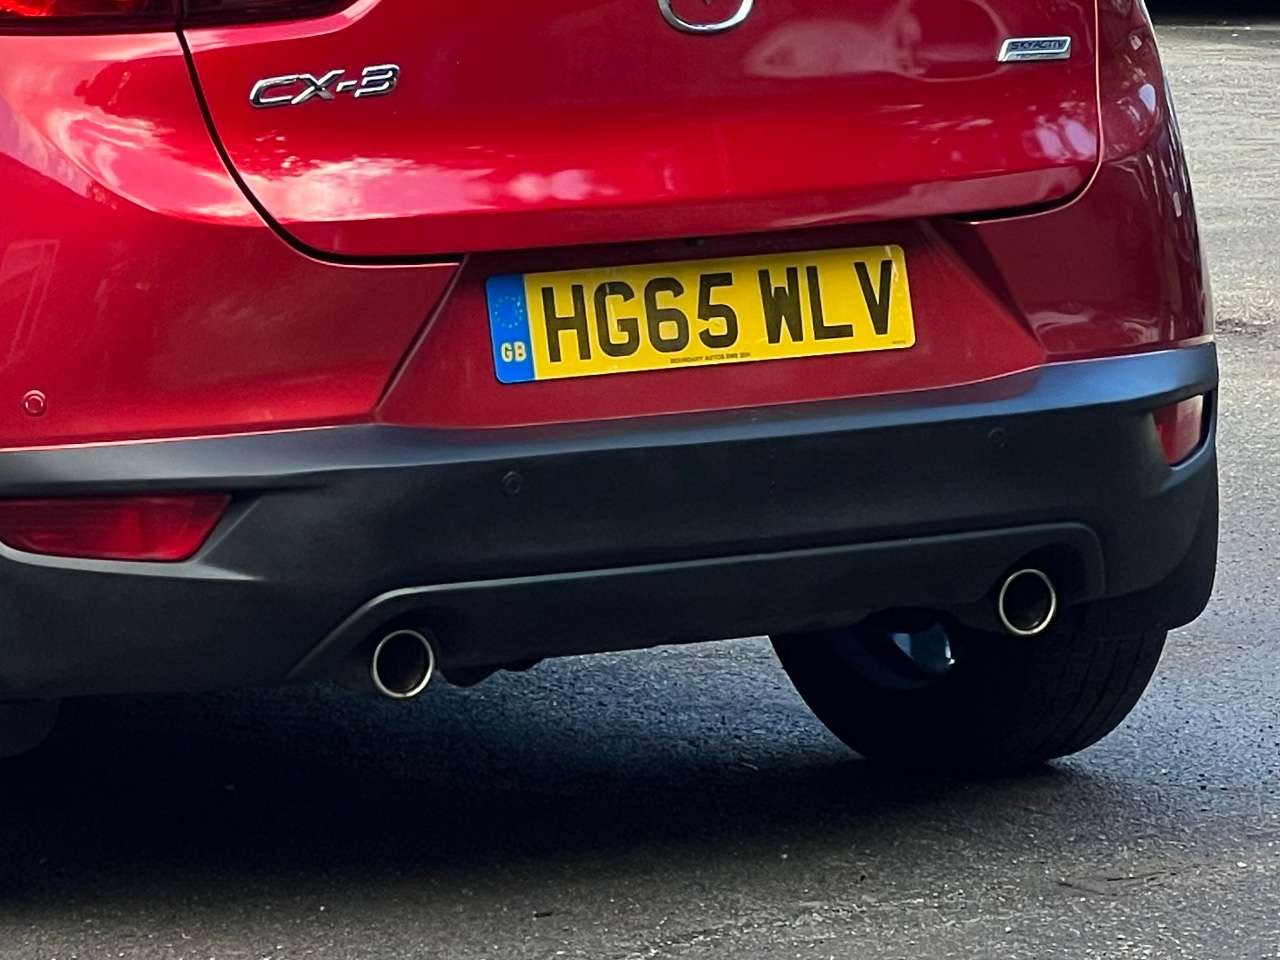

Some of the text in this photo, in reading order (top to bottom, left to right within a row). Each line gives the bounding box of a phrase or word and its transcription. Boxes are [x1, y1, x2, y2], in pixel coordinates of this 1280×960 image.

[249, 63, 401, 108] CX-3
[540, 259, 893, 364] HG65 WLV
[500, 341, 526, 363] GB
